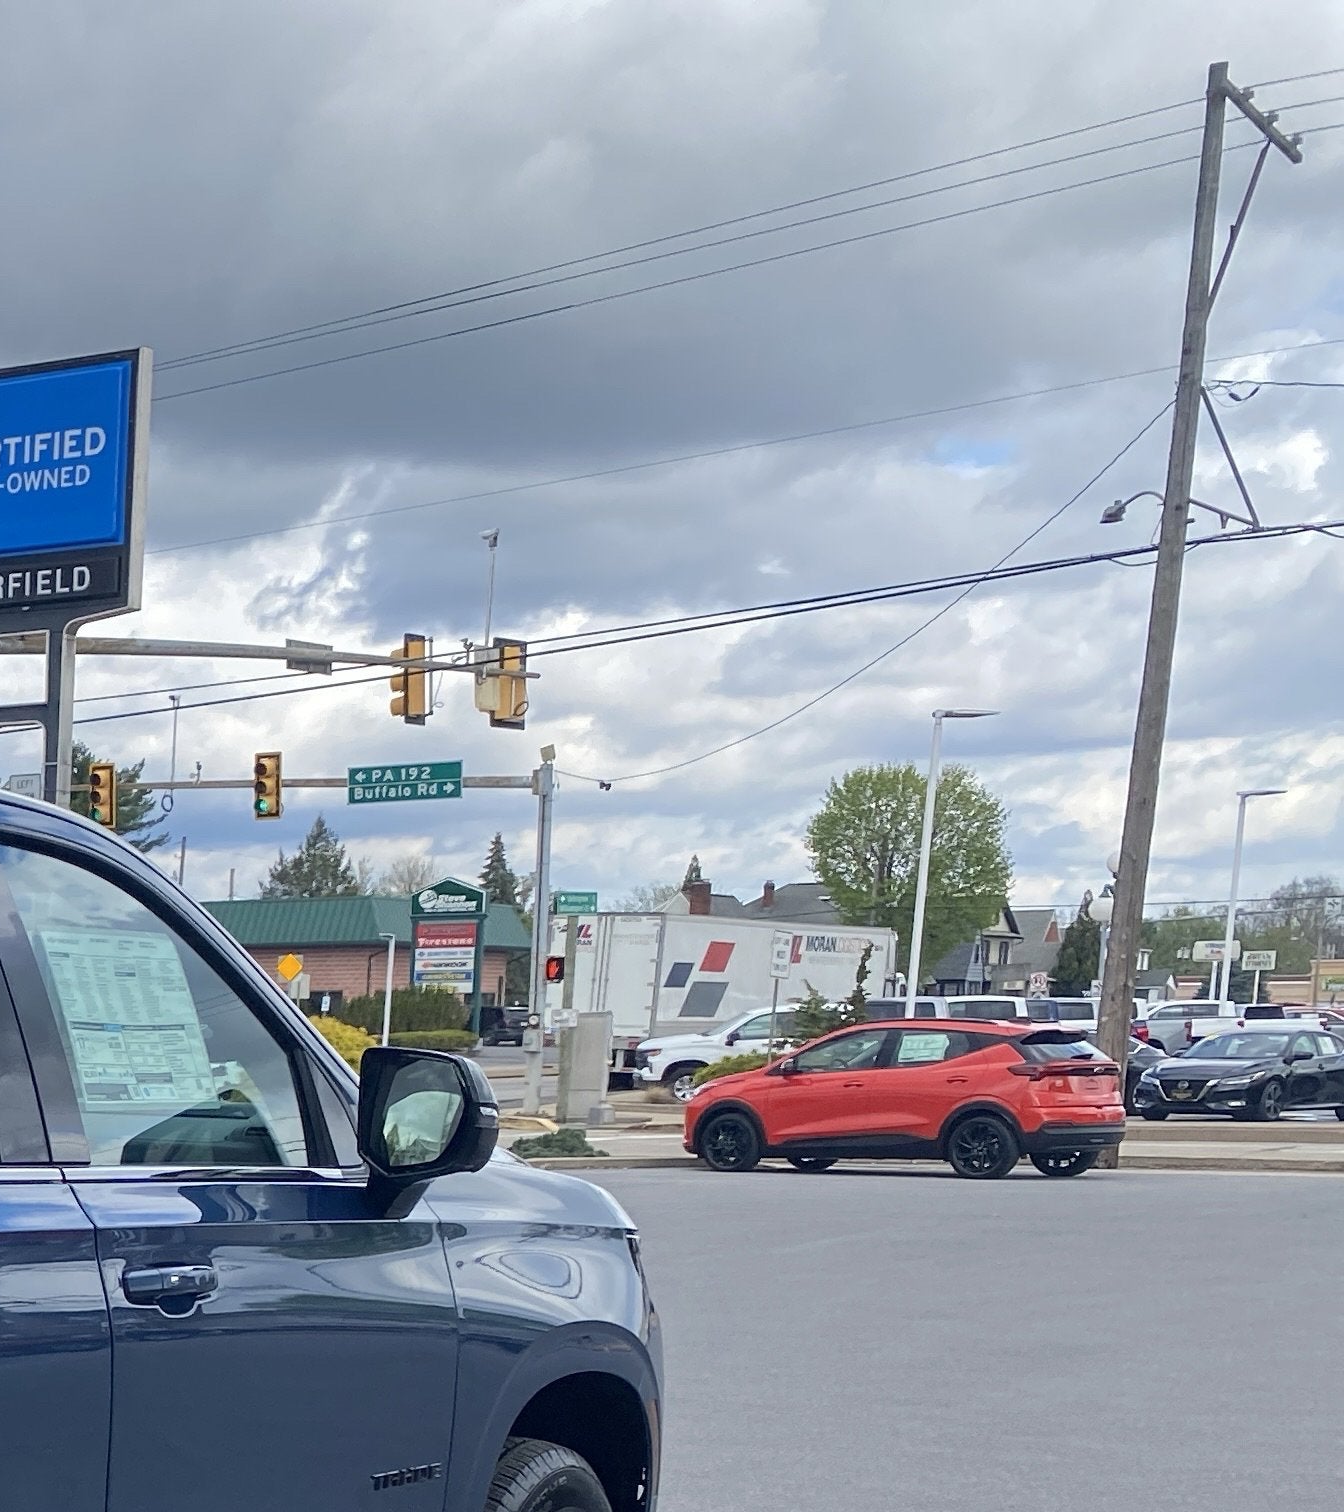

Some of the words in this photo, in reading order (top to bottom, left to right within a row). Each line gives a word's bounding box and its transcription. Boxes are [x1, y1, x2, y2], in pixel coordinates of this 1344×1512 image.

[372, 769, 393, 783] PA
[400, 766, 431, 780] 192
[354, 785, 412, 800] Buffalo
[417, 783, 438, 796] Rd
